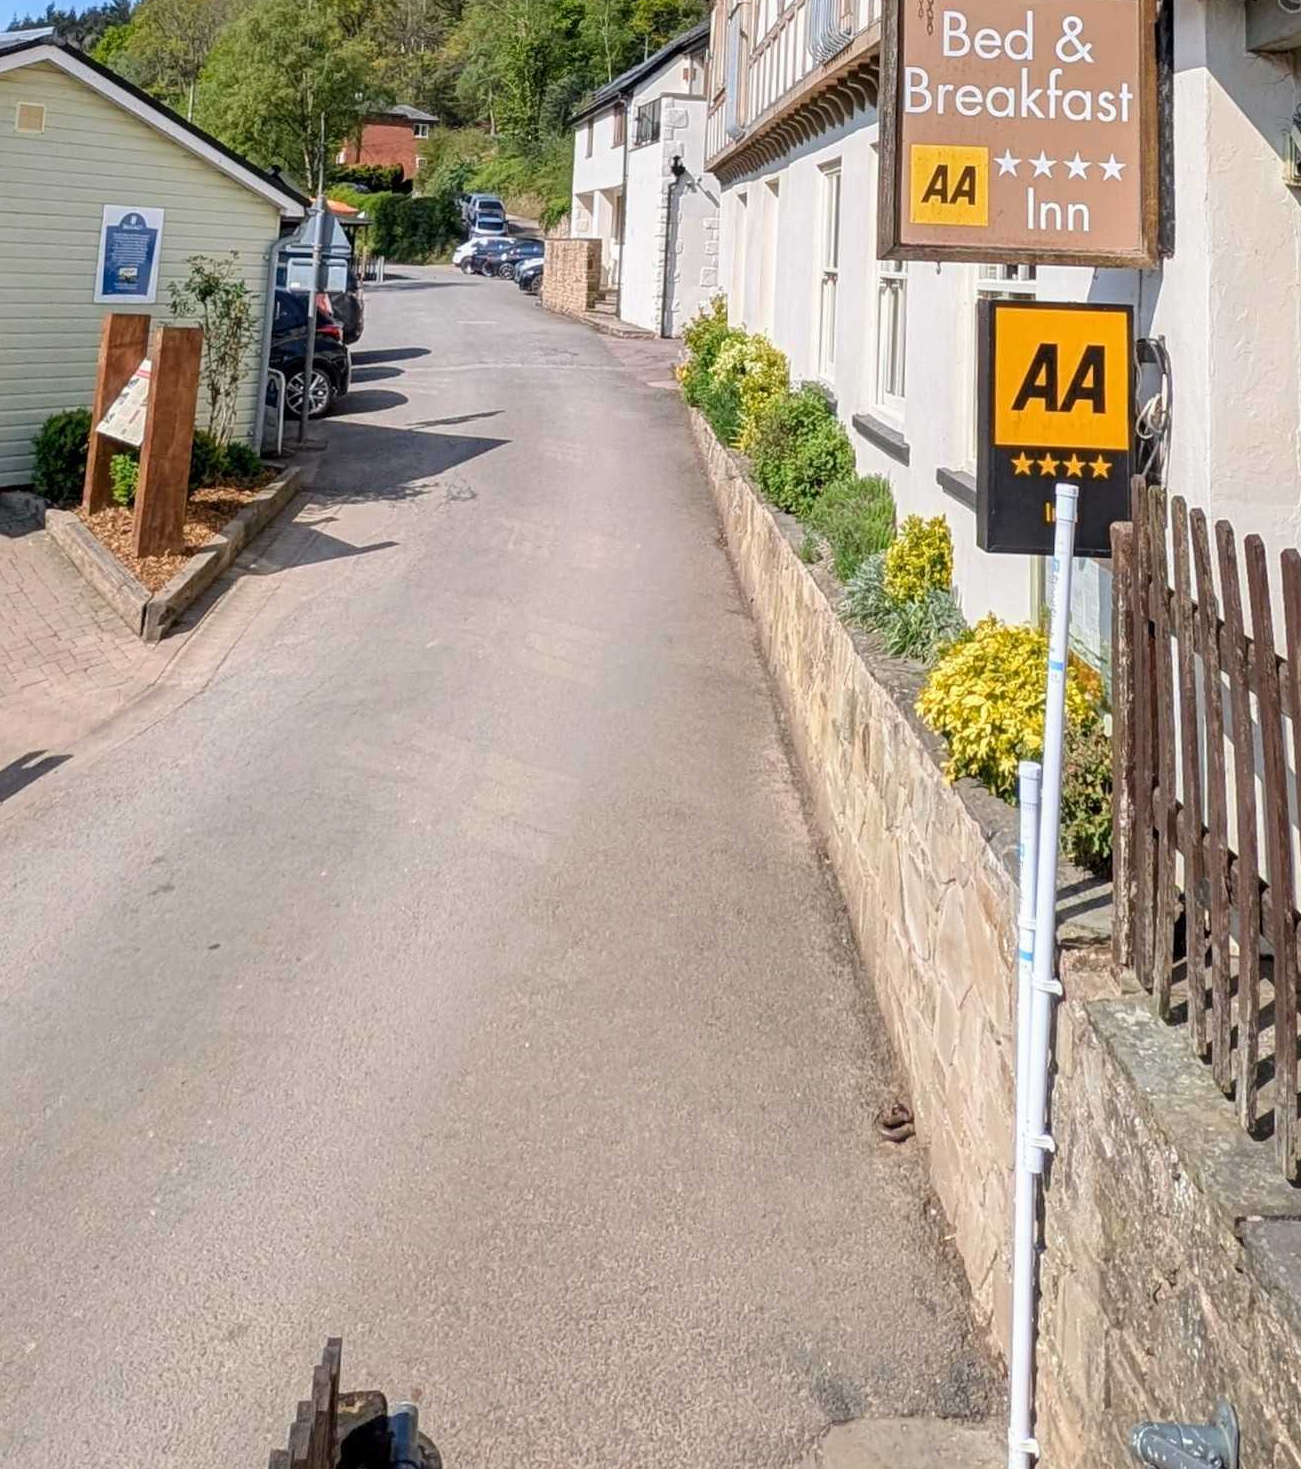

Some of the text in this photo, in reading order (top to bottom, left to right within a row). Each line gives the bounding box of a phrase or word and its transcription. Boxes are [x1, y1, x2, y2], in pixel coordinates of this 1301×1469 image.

[942, 10, 1094, 63] Bed &
[904, 66, 1133, 122] Breakfast
[920, 164, 976, 206] AA
[1027, 187, 1089, 232] Inn
[1011, 343, 1106, 414] AA
